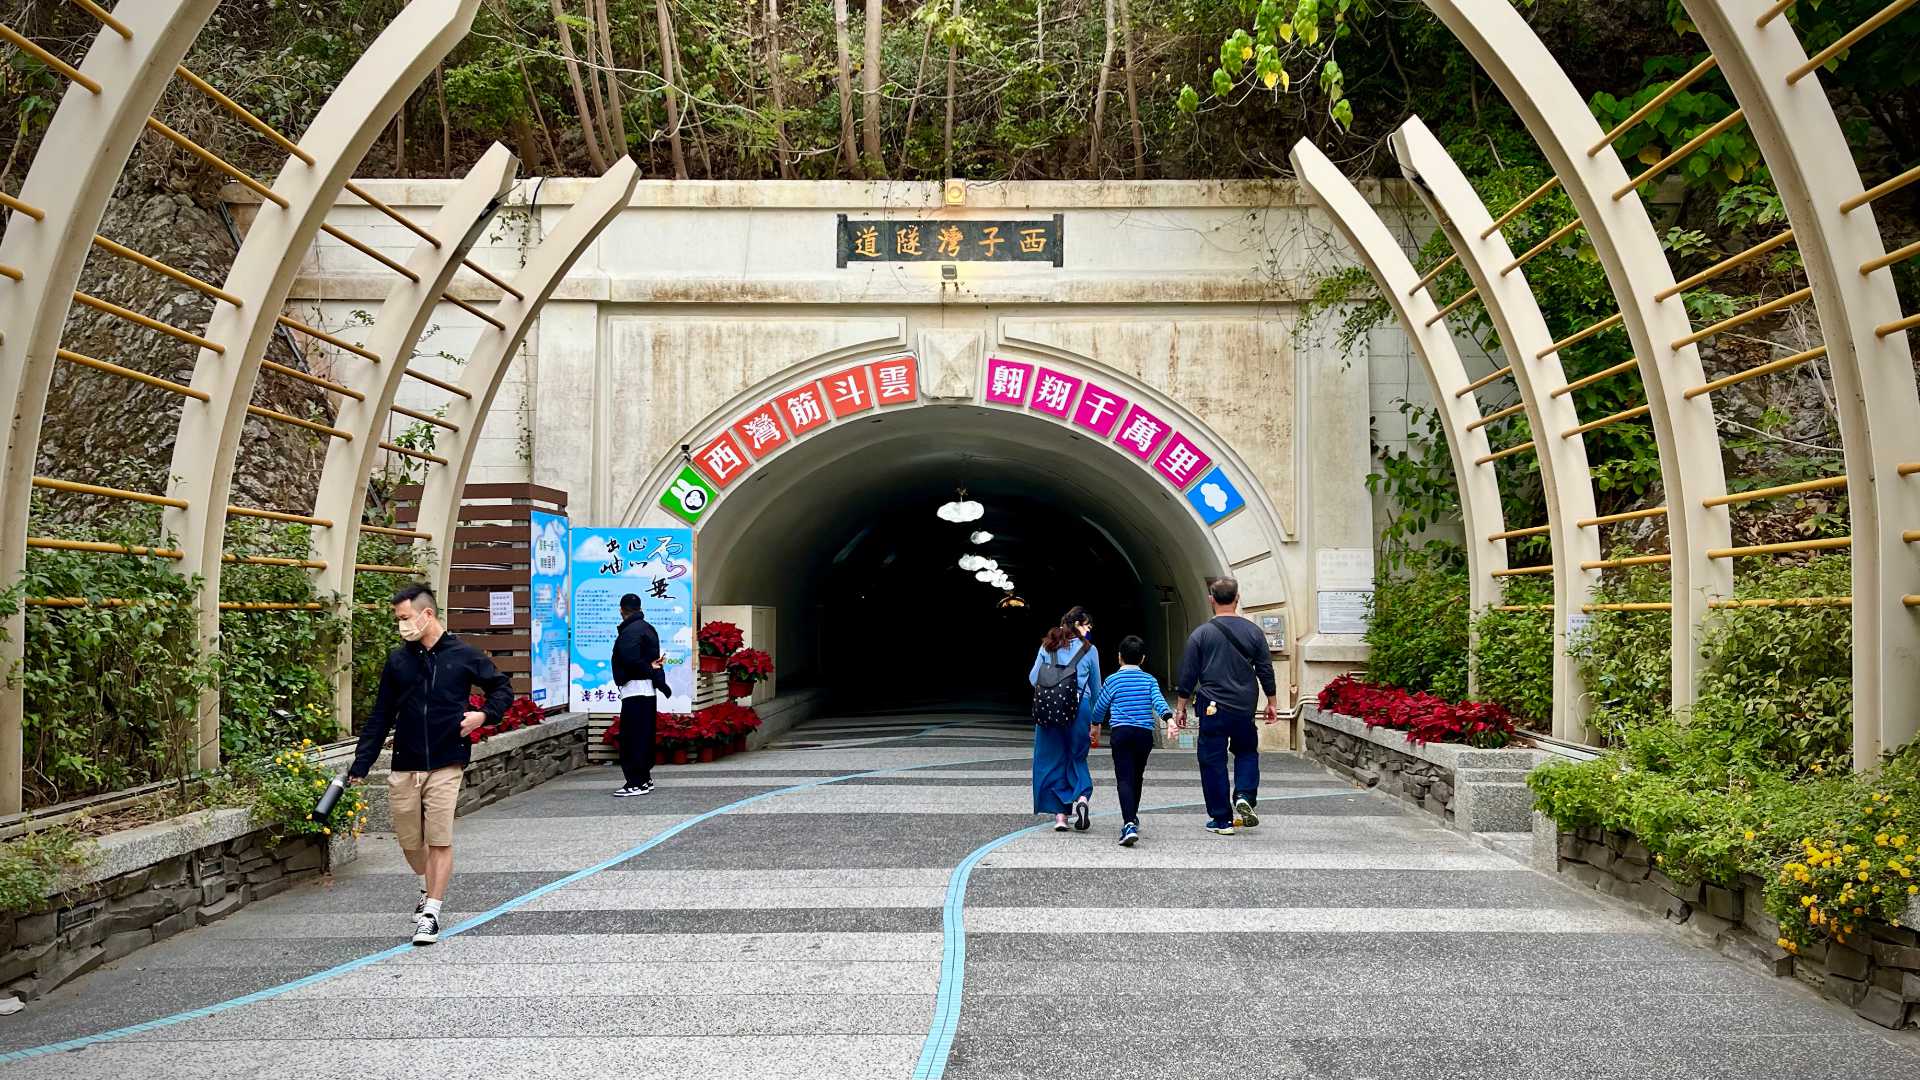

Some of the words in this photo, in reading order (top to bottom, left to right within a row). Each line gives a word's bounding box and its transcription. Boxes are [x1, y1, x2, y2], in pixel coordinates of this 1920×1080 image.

[703, 365, 910, 480] 西灣筋斗雲
[991, 365, 1200, 482] 翱翔千萬里
[582, 689, 621, 702] 漫步在
